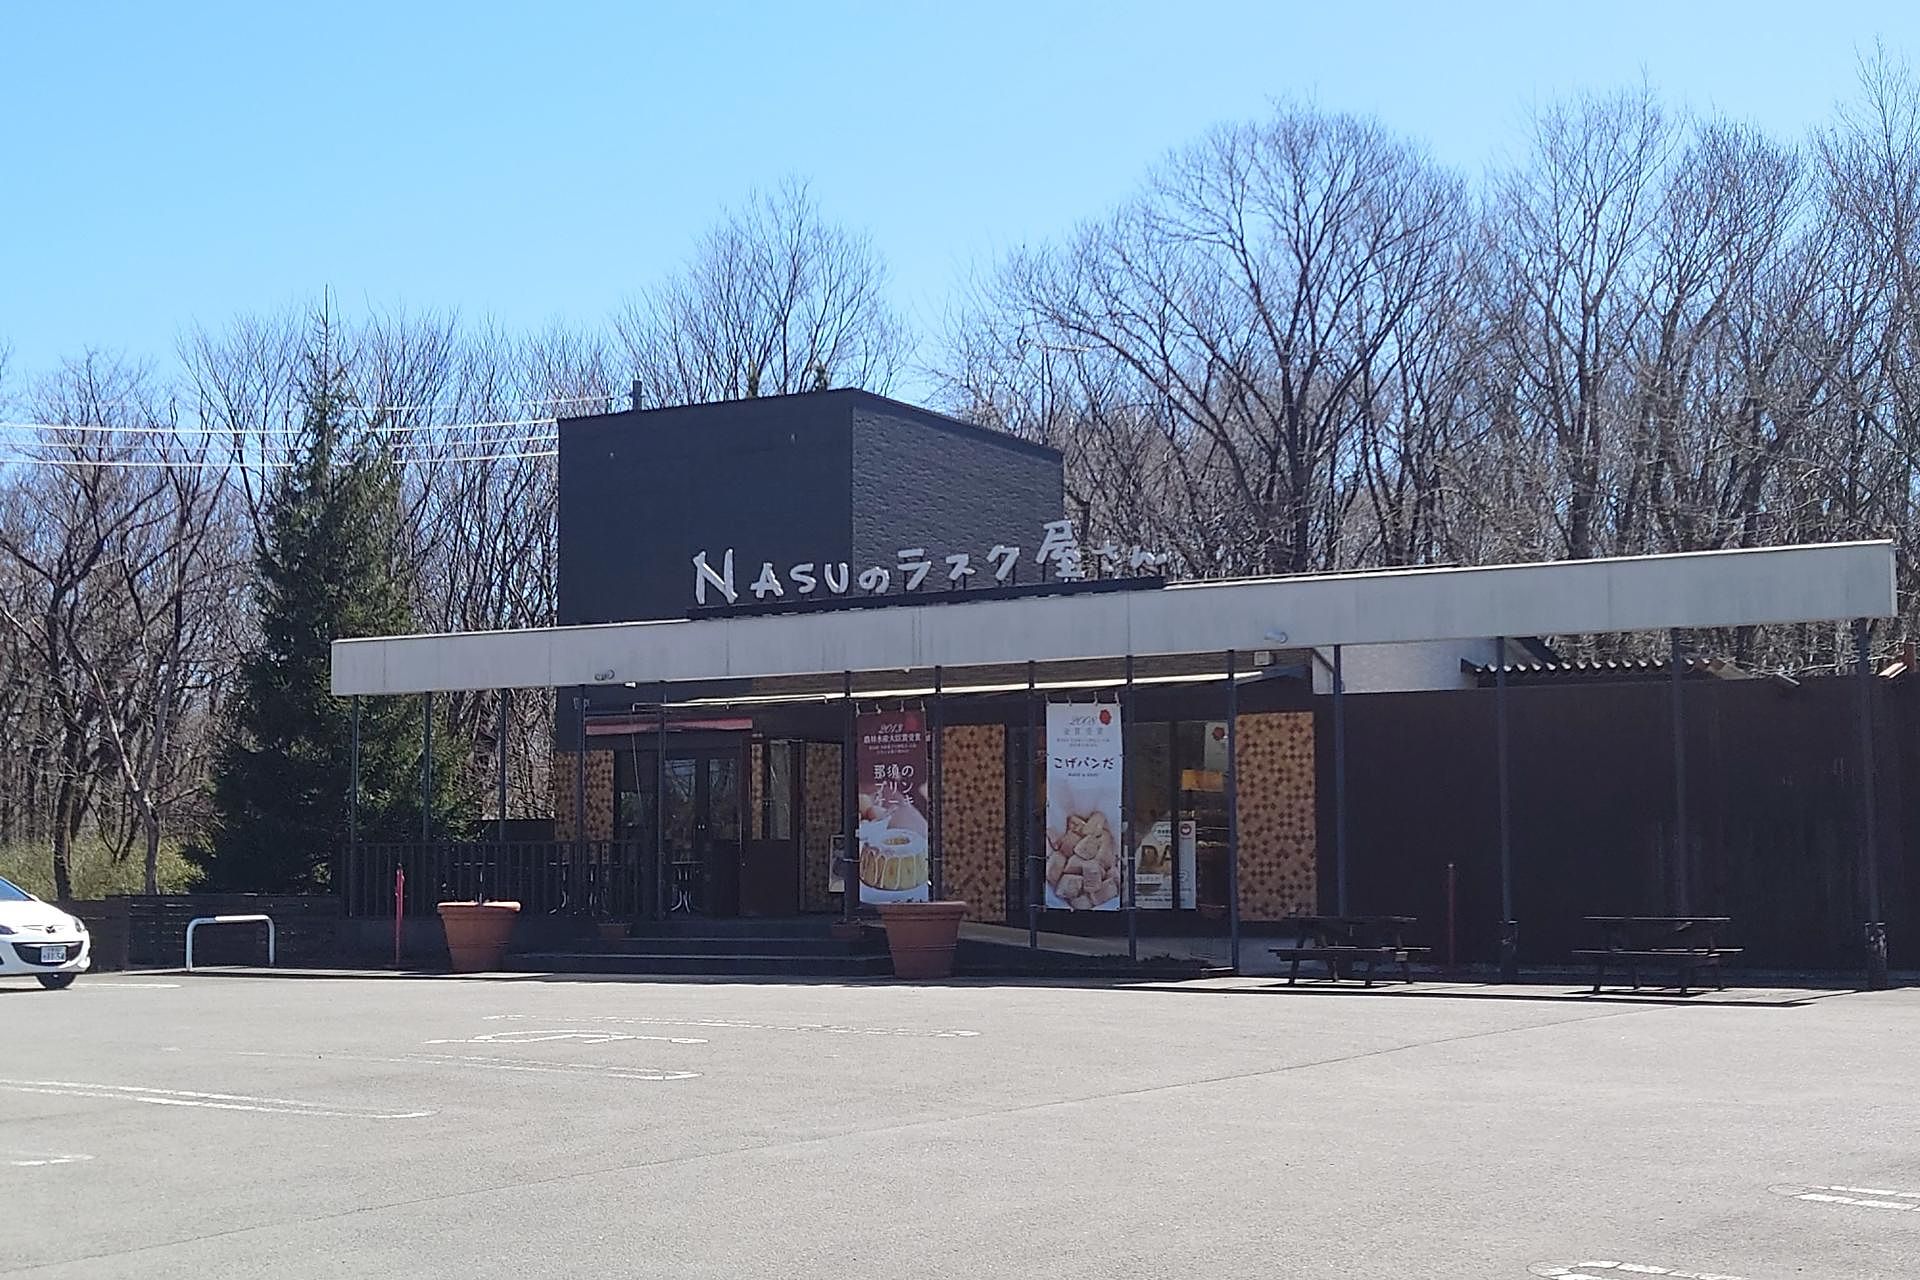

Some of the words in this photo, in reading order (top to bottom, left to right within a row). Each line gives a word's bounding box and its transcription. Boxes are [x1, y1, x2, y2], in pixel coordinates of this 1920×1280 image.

[1054, 756, 1114, 770] こげパンだ
[873, 764, 914, 779] 那須の
